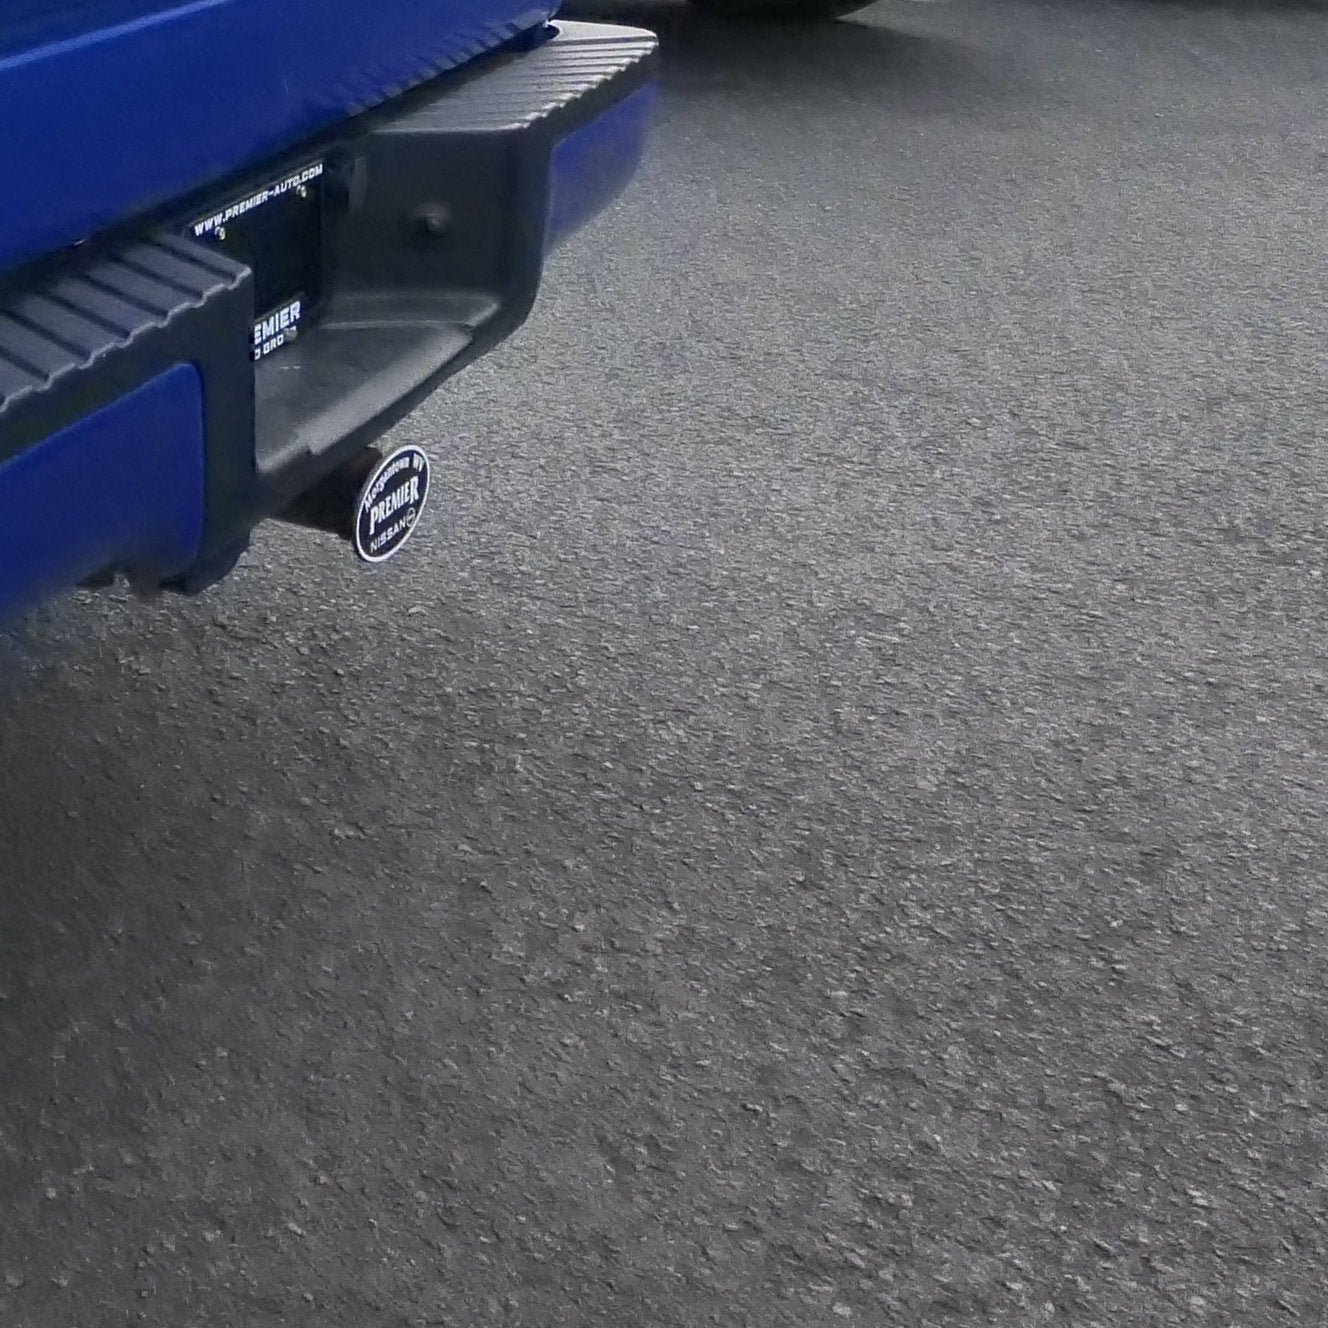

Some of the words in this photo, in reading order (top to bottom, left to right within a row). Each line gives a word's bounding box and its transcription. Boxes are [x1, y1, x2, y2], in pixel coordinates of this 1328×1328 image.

[194, 163, 323, 237] WWW.PREMIER-AUTO.COM
[254, 300, 301, 346] EMIER
[369, 475, 419, 536] PREMIER
[370, 517, 406, 553] NISSAN
